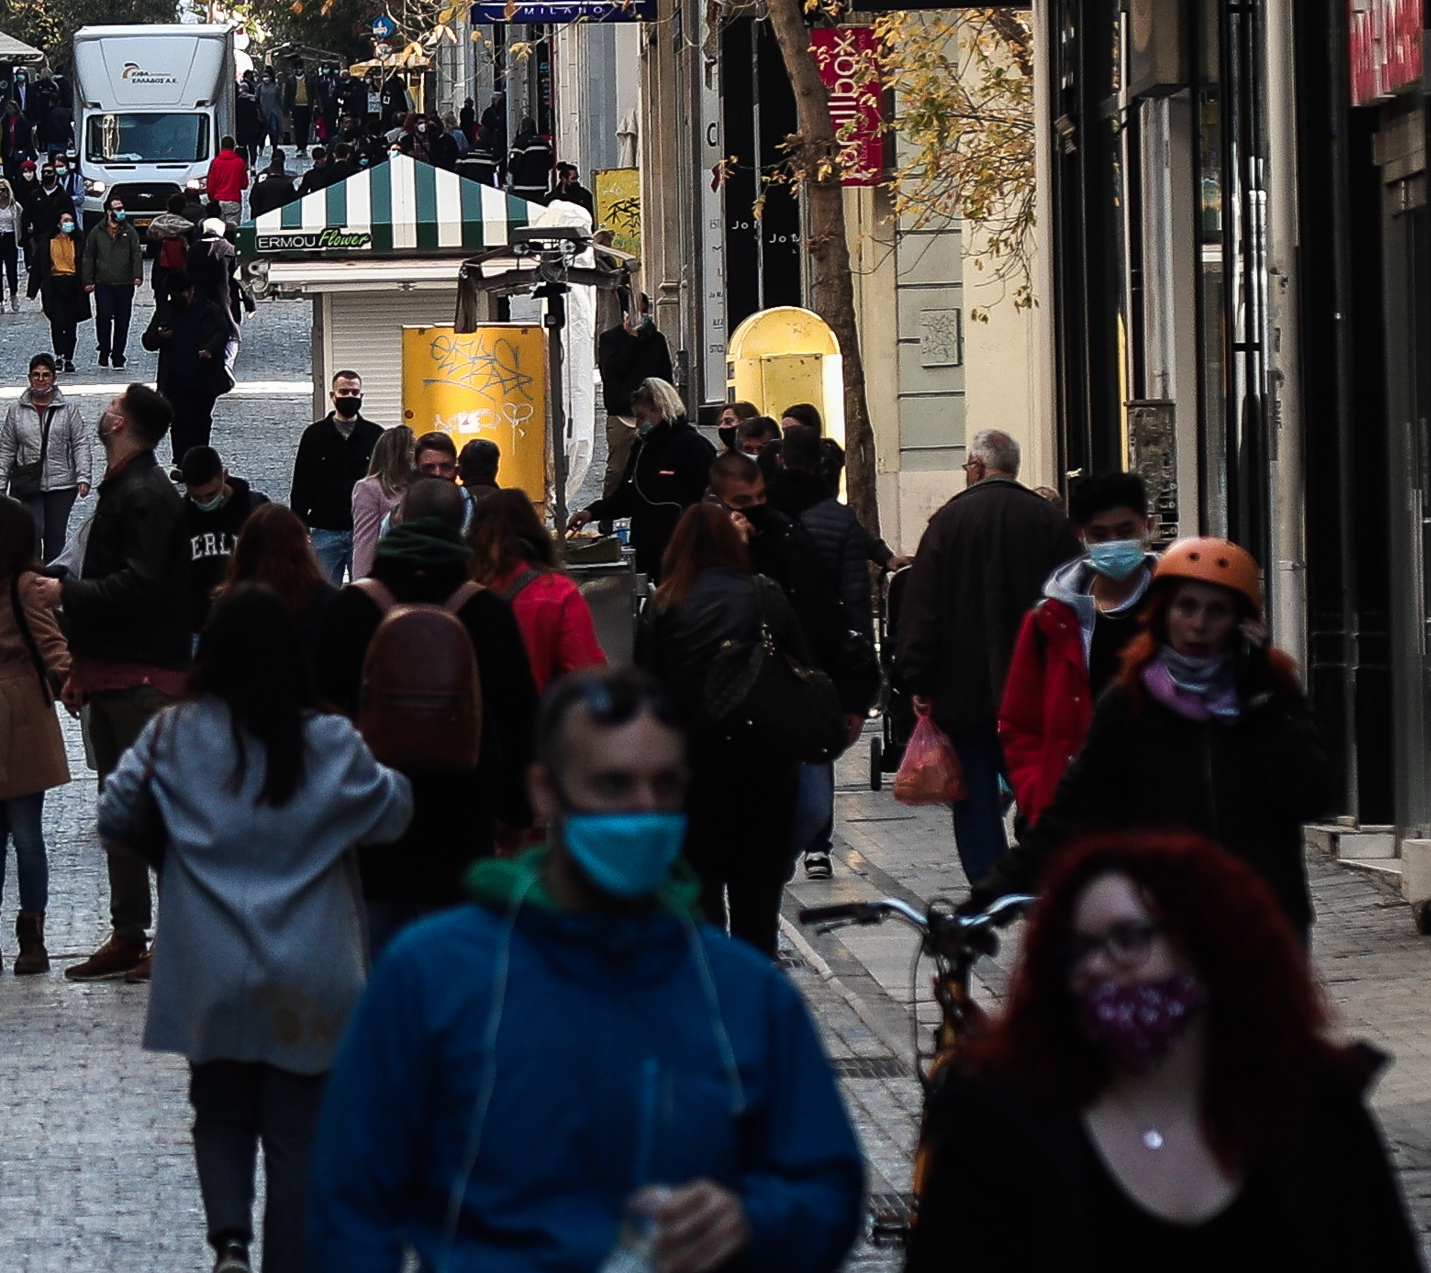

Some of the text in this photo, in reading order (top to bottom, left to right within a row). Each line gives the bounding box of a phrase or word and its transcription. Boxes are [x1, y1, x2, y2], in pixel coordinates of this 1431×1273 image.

[524, 6, 604, 16] MILANO
[257, 228, 372, 250] ERMOU Flower
[190, 531, 239, 561] ERL
